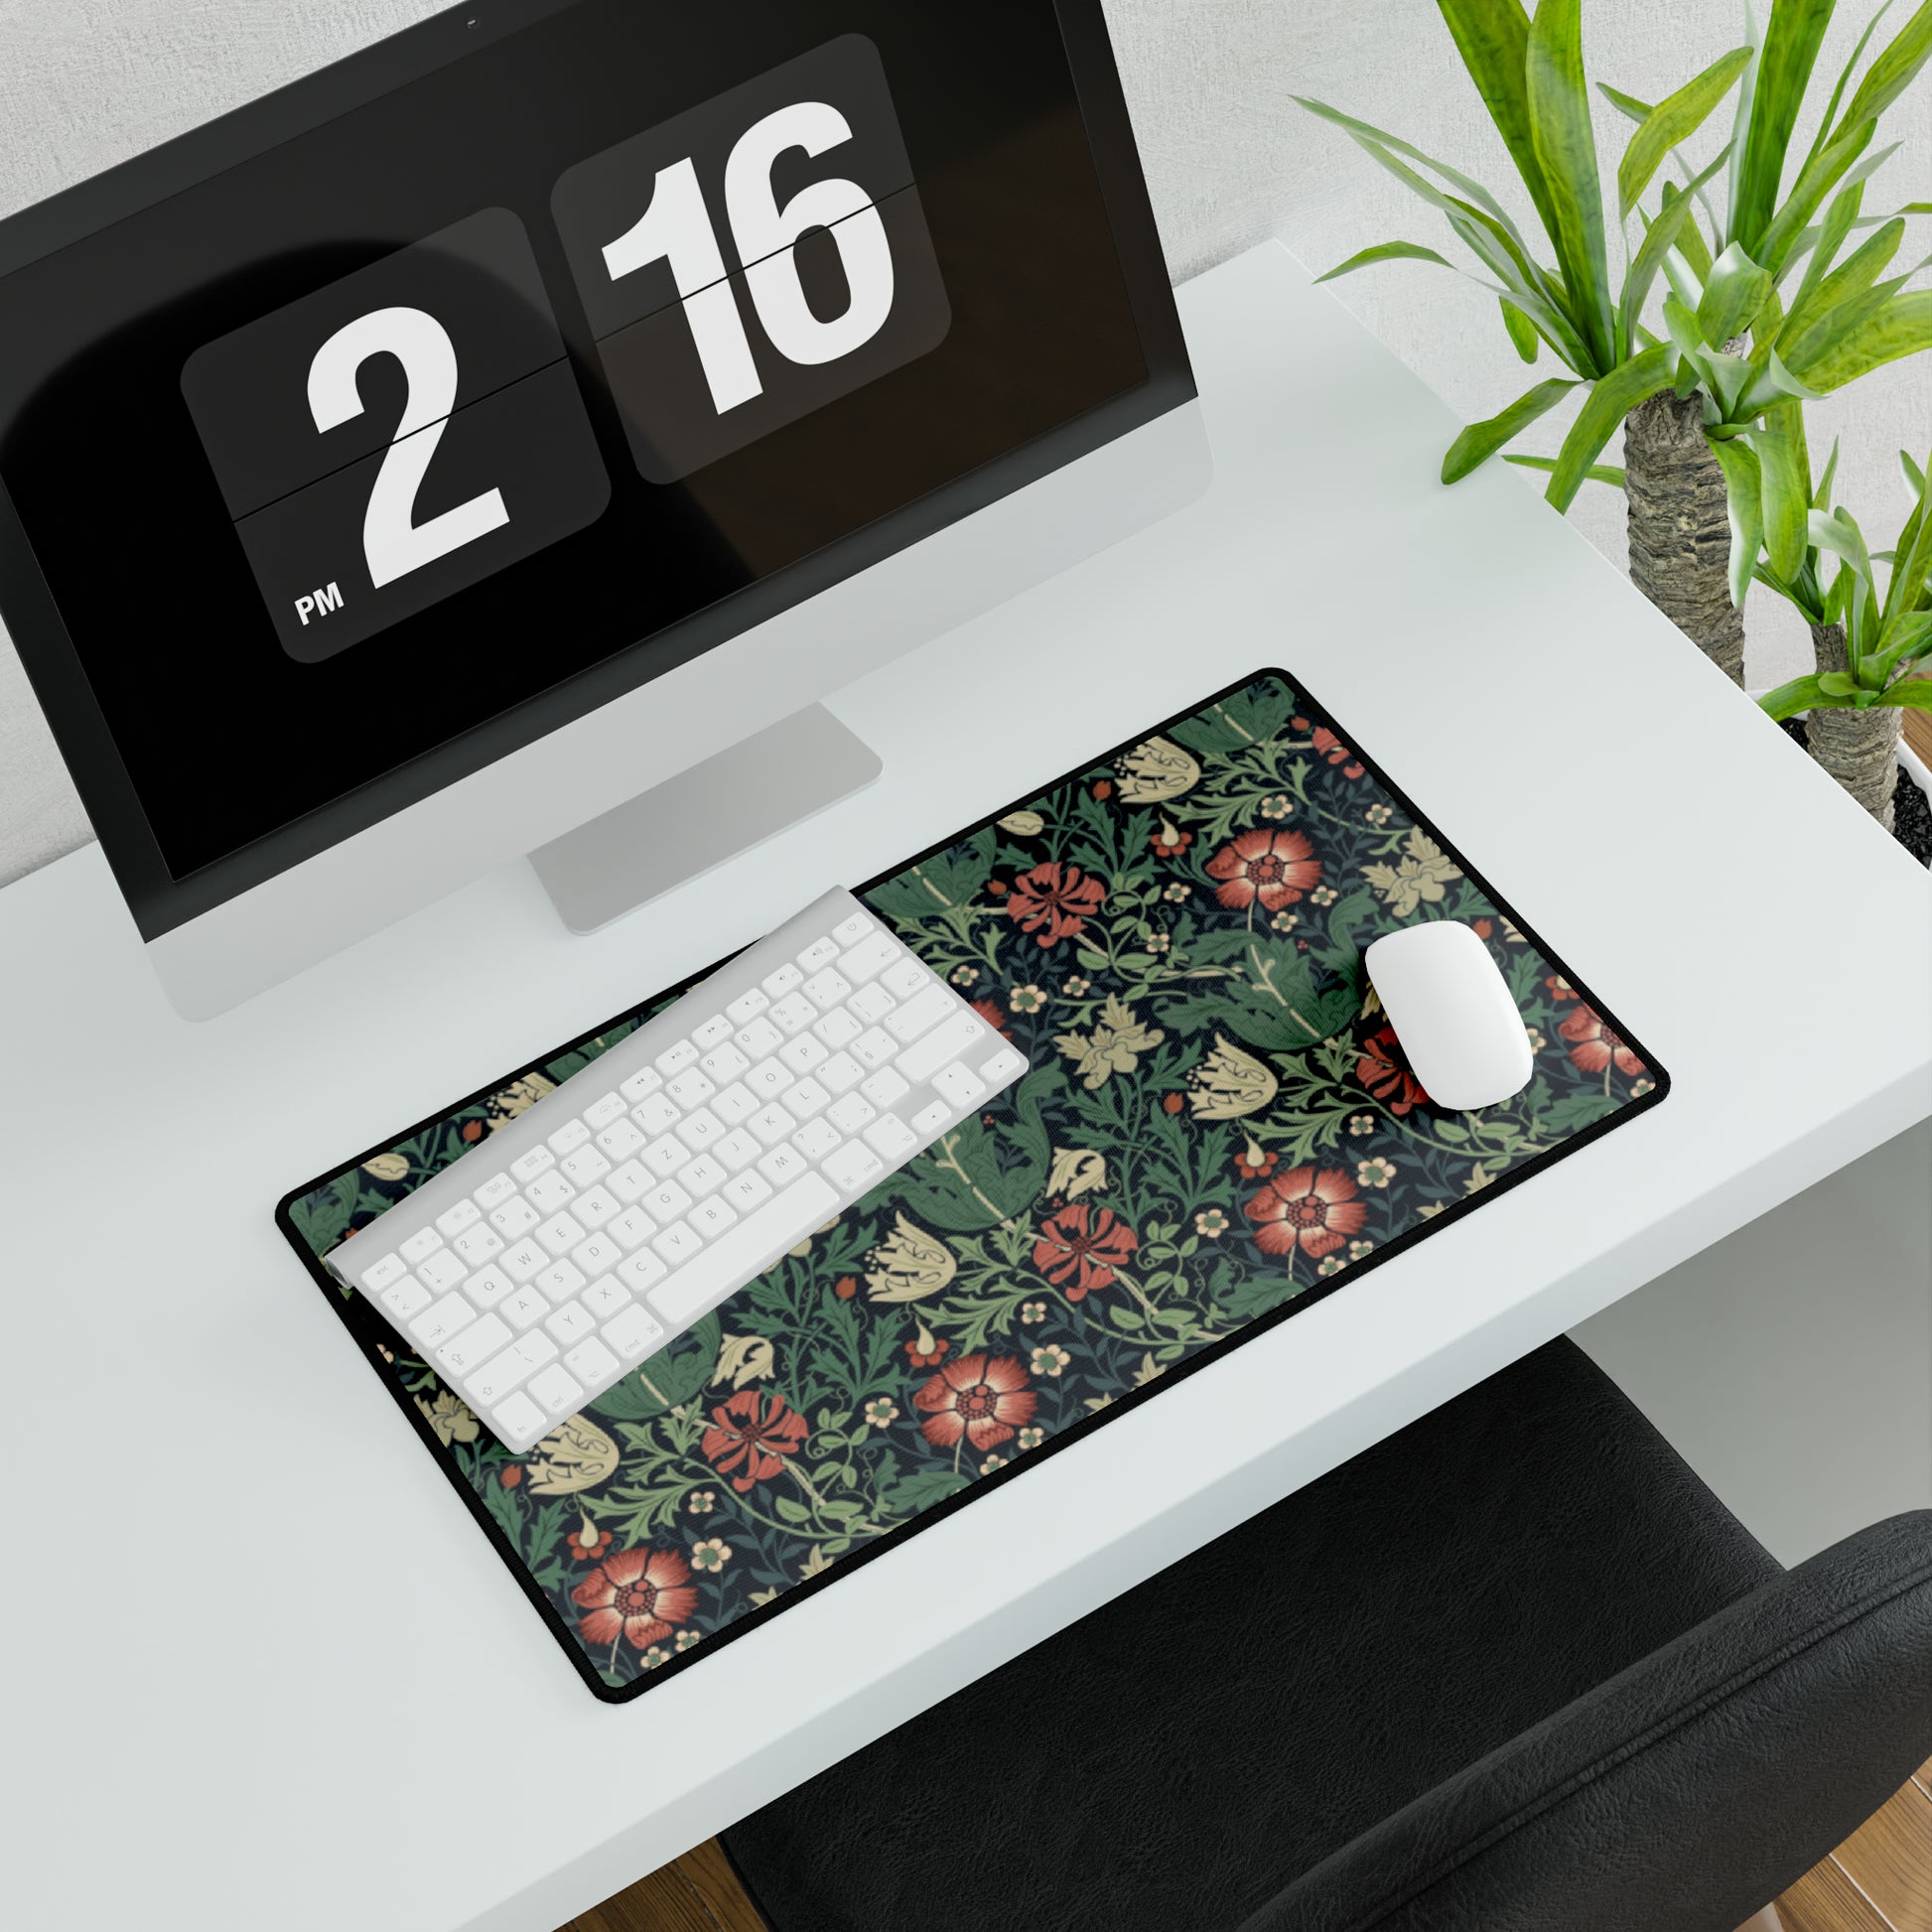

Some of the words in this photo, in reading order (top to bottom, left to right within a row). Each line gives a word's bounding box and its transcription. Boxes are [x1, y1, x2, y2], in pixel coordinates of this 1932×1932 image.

[307, 307, 507, 589] 2
[601, 101, 896, 415] 16
[294, 581, 345, 624] PM
[799, 1047, 808, 1057] P
[706, 1058, 716, 1068] 9
[671, 1084, 682, 1094] 8
[798, 1092, 810, 1101] L
[636, 1109, 645, 1120] 7
[763, 1115, 776, 1126] K
[695, 1123, 708, 1135] U
[604, 1136, 612, 1145] 6
[731, 1142, 740, 1152] J
[660, 1149, 673, 1161] Z
[567, 1161, 577, 1172] 5
[774, 1156, 789, 1169] M
[693, 1167, 707, 1178] H
[625, 1174, 636, 1184] T
[533, 1186, 542, 1195] 4
[740, 1181, 754, 1194] N
[659, 1192, 671, 1204] G
[591, 1201, 603, 1212] R
[495, 1213, 506, 1223] 3
[706, 1209, 717, 1220] B
[624, 1219, 633, 1230] F
[555, 1227, 566, 1238] E
[460, 1239, 471, 1250] 2
[670, 1234, 681, 1245] V
[588, 1246, 601, 1258] D
[517, 1252, 532, 1266] W
[635, 1261, 647, 1272] C
[553, 1273, 564, 1284] S
[599, 1288, 612, 1301] X
[517, 1300, 529, 1311] A
[563, 1314, 573, 1325] Y
